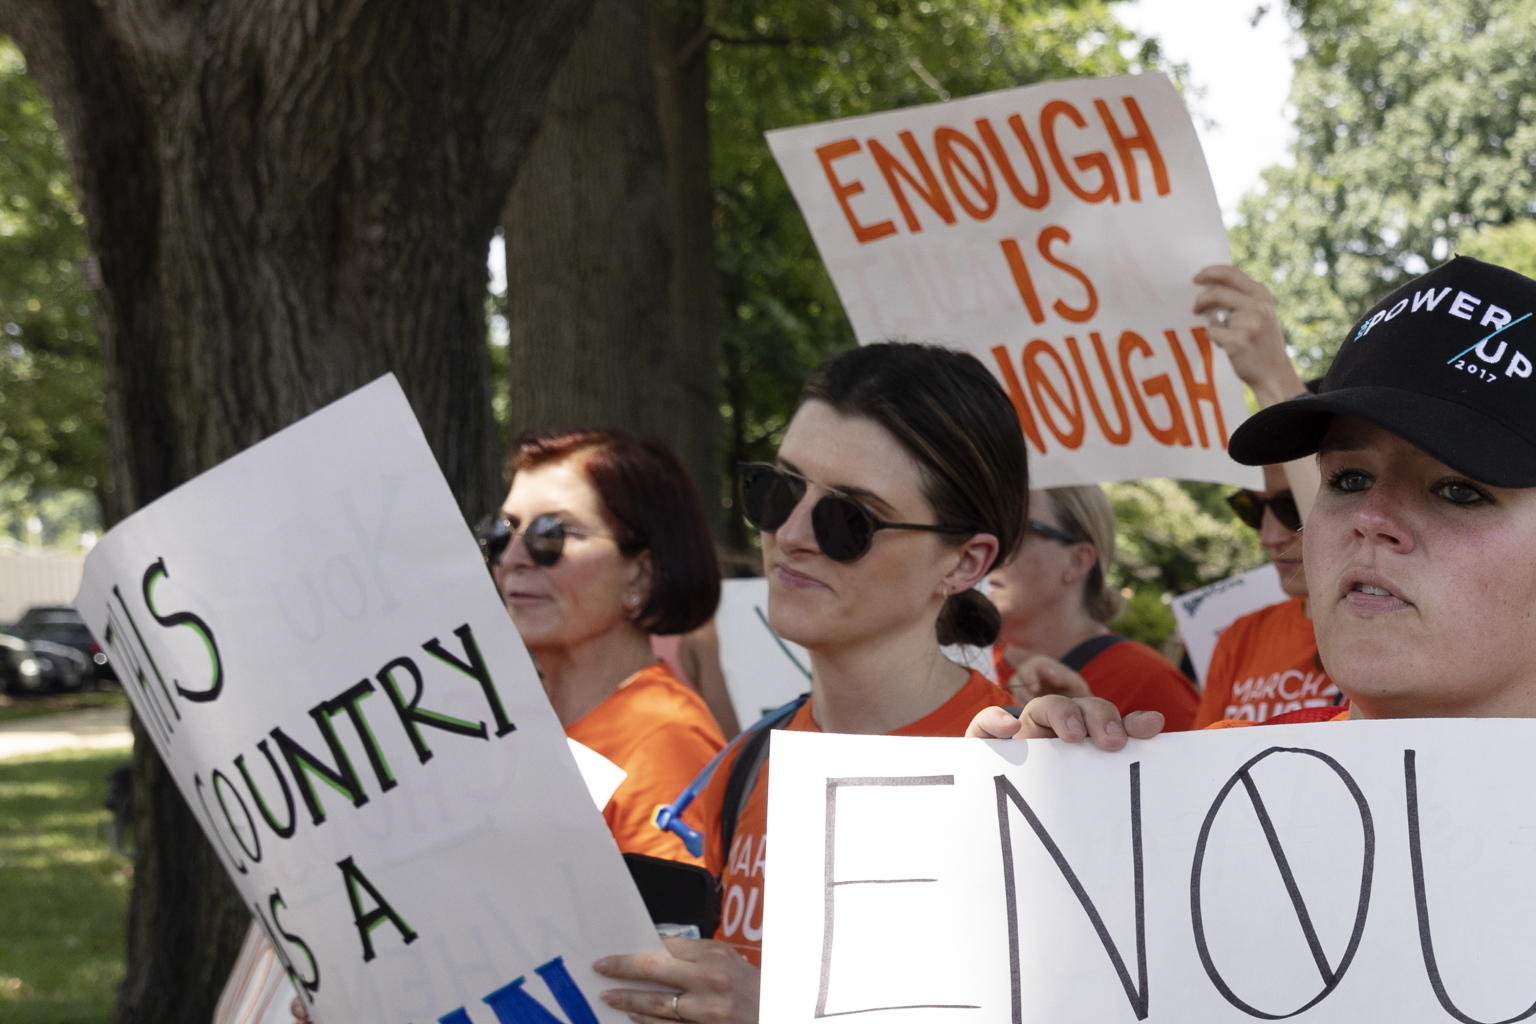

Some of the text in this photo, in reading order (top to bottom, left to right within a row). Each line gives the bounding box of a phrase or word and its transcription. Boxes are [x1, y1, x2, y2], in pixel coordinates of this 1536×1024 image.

[815, 96, 1171, 245] ENOUGH
[1000, 225, 1099, 325] IS
[1454, 359, 1497, 383] 2017
[1474, 340, 1533, 379] UP
[194, 622, 516, 875] COUNTRY
[336, 855, 418, 963] A
